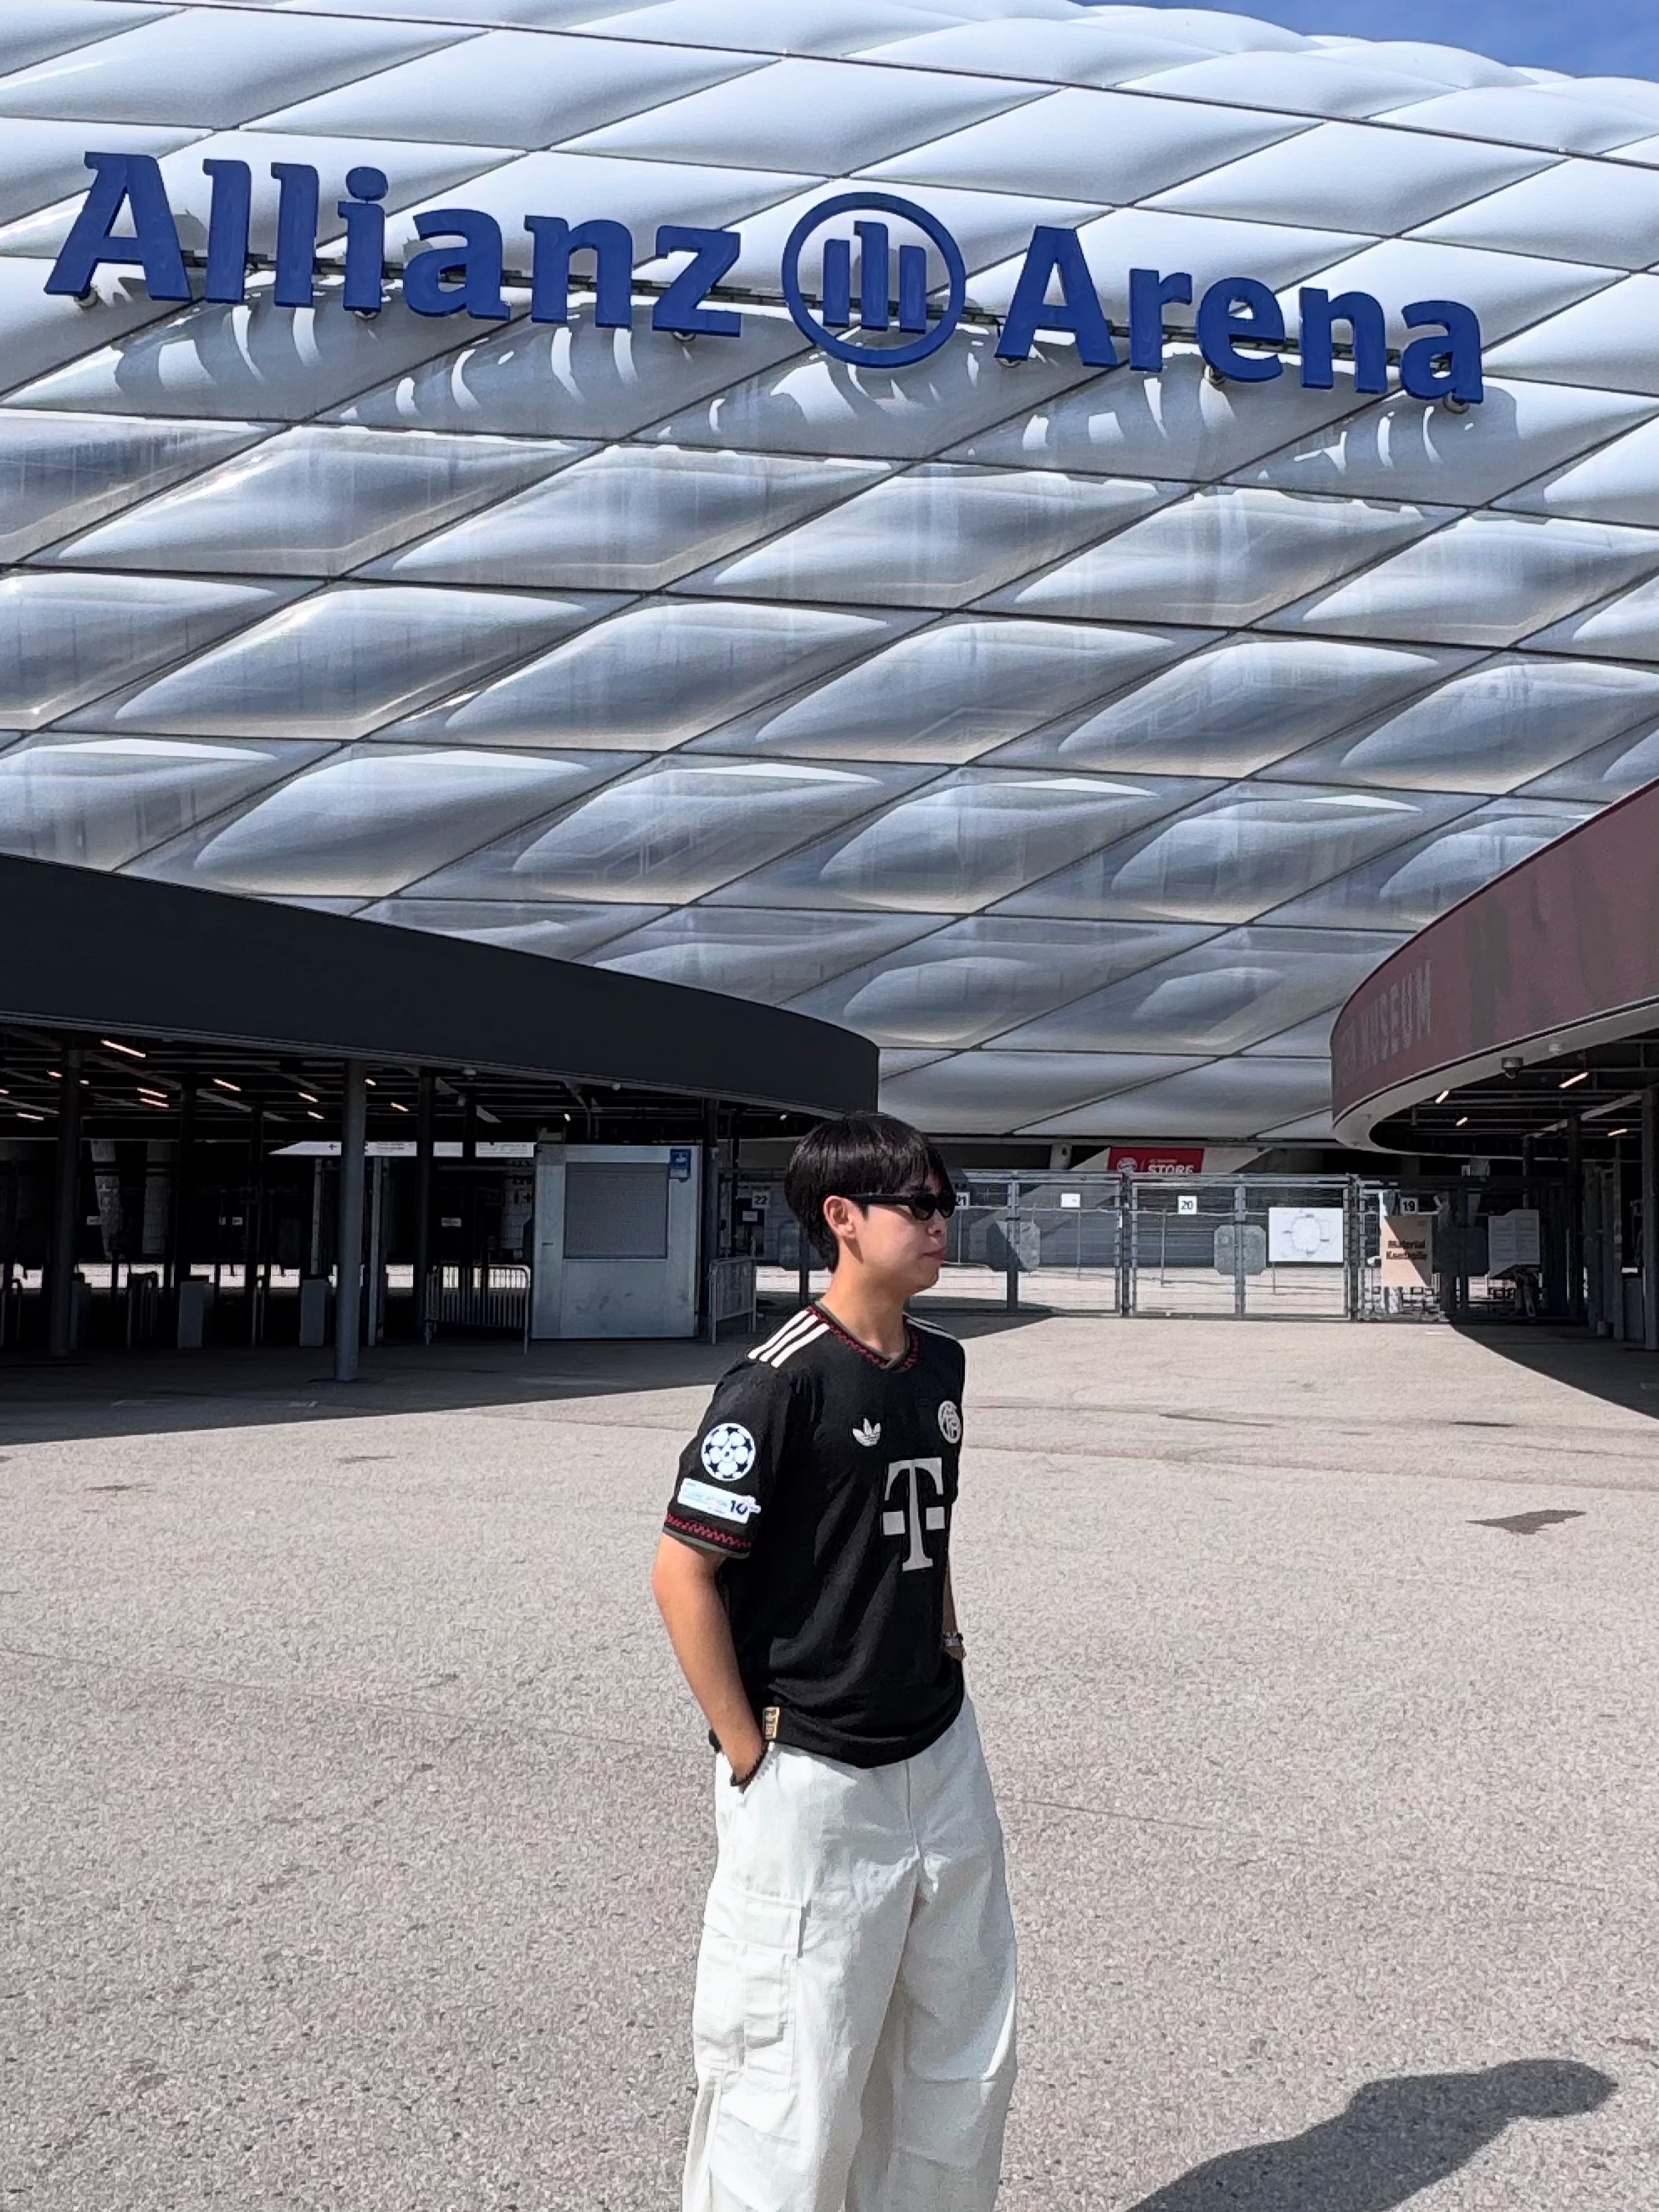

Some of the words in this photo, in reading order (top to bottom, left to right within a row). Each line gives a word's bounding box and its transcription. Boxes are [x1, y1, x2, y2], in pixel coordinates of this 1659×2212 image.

[45, 151, 741, 337] Allianz
[994, 224, 1483, 404] Arena
[753, 1195, 768, 1205] 22
[1180, 1200, 1193, 1210] 20
[1402, 1200, 1416, 1212] 19
